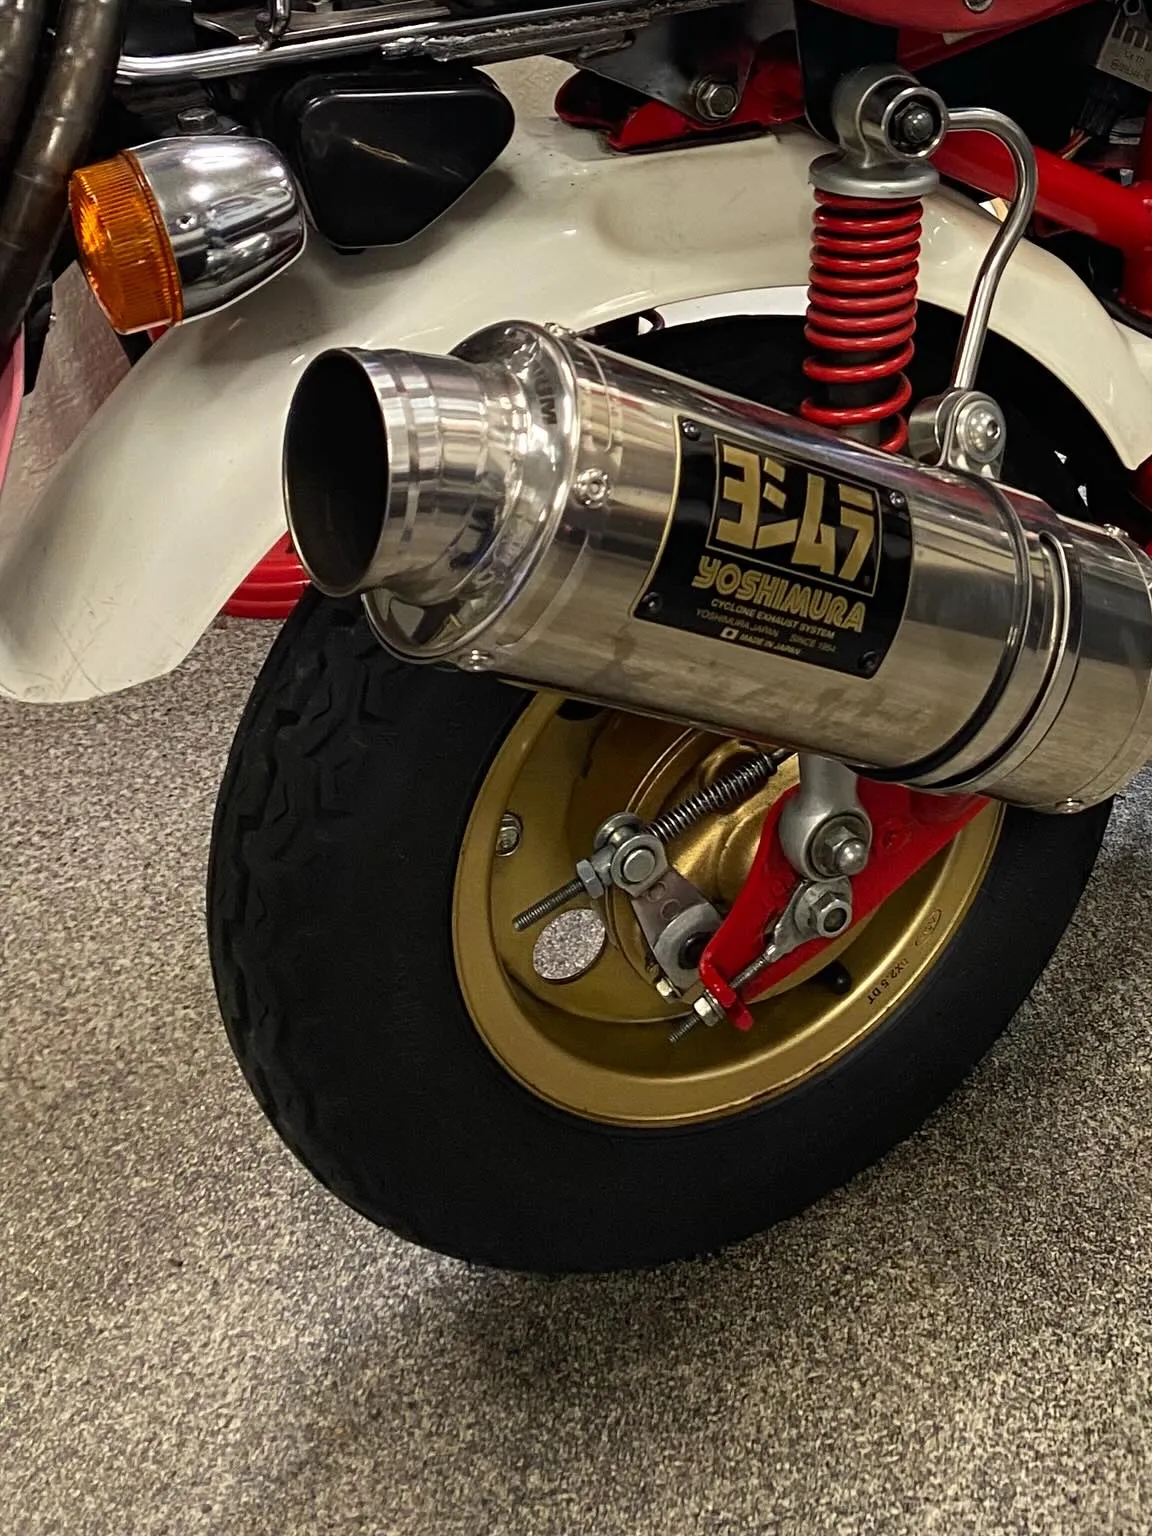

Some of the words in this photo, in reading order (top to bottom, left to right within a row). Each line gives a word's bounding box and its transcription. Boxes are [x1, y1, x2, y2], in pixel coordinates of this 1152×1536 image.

[715, 444, 875, 582] ヨシムラ
[691, 555, 867, 633] YOSHIMURA
[711, 598, 757, 618] CYCLONE
[756, 611, 800, 629] EXHAUST
[799, 623, 836, 640] SYSTEM
[739, 632, 764, 645] MADE
[765, 638, 773, 648] IN
[773, 641, 801, 656] JAPAN
